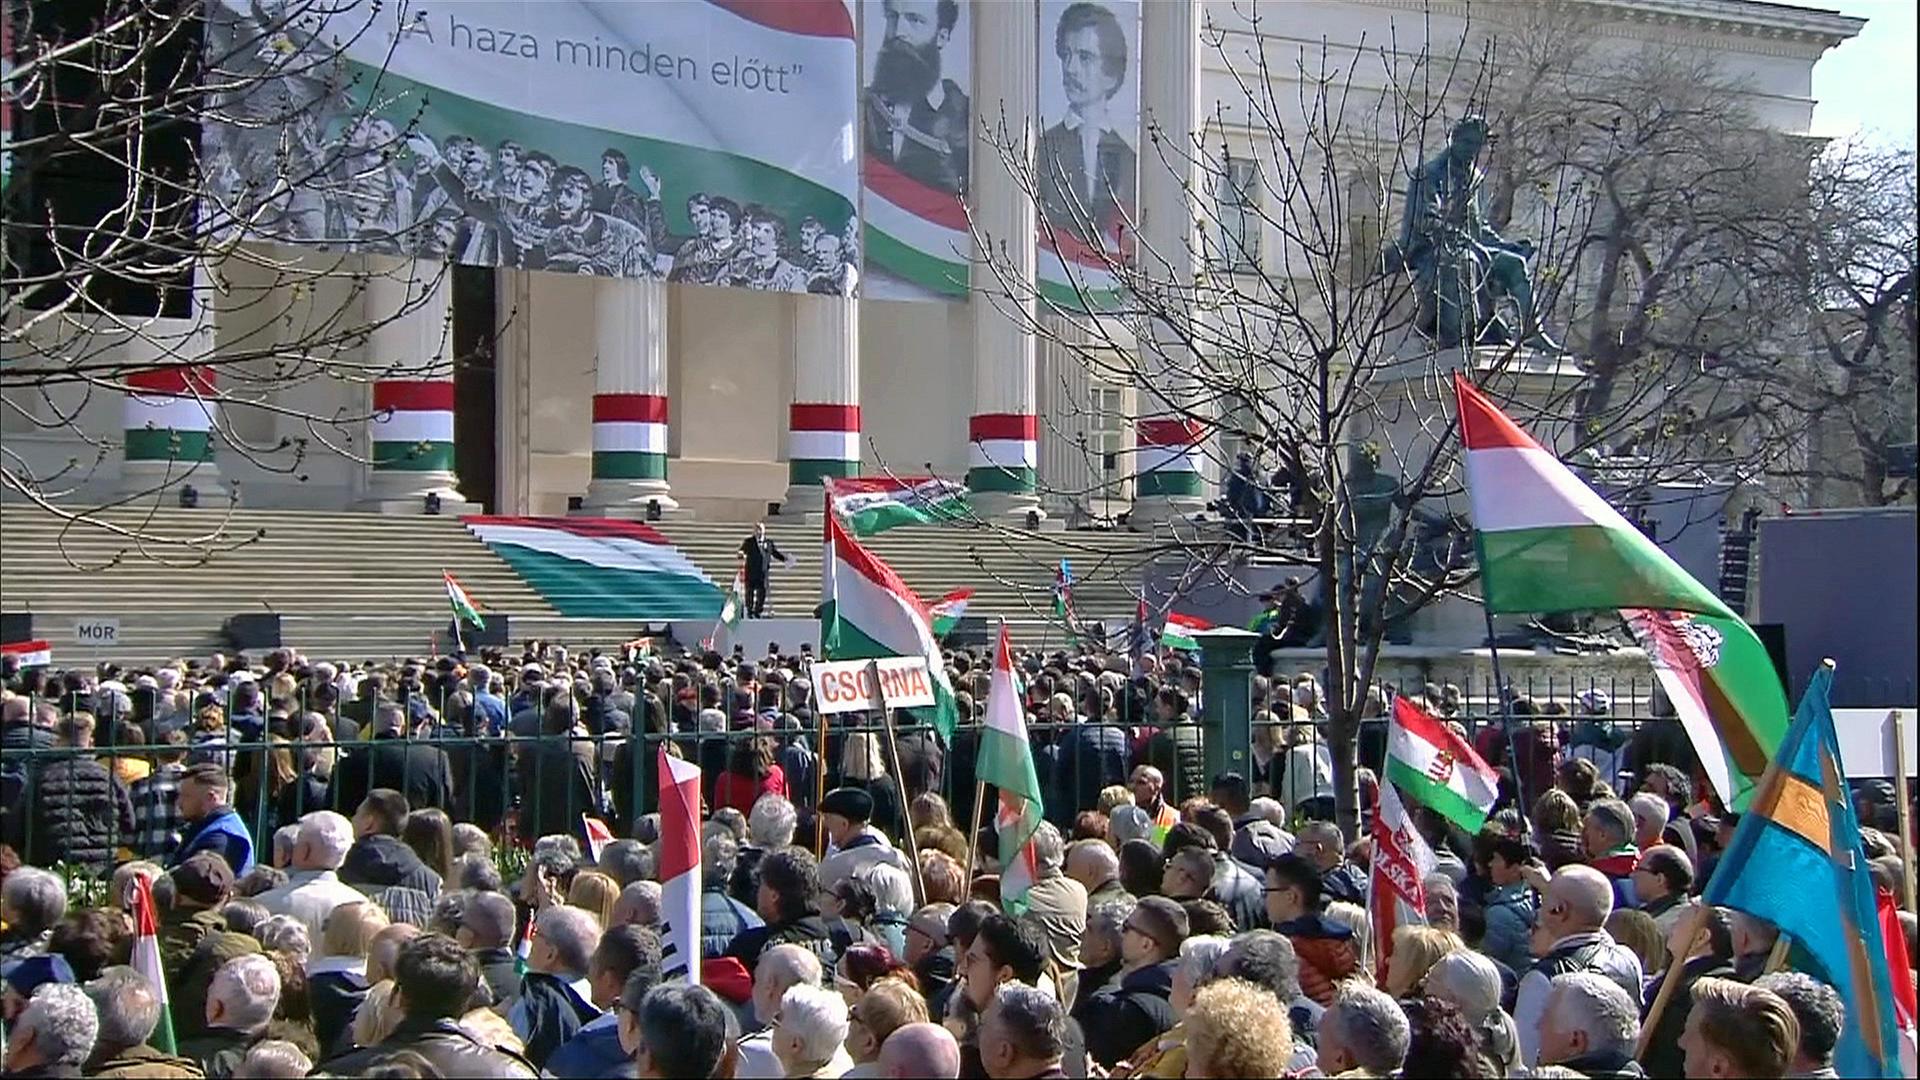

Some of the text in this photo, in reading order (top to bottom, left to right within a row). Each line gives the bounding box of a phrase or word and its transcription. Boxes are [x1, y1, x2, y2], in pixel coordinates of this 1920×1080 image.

[449, 14, 539, 60] haza
[554, 36, 697, 81] minden
[78, 622, 115, 639] MÓR
